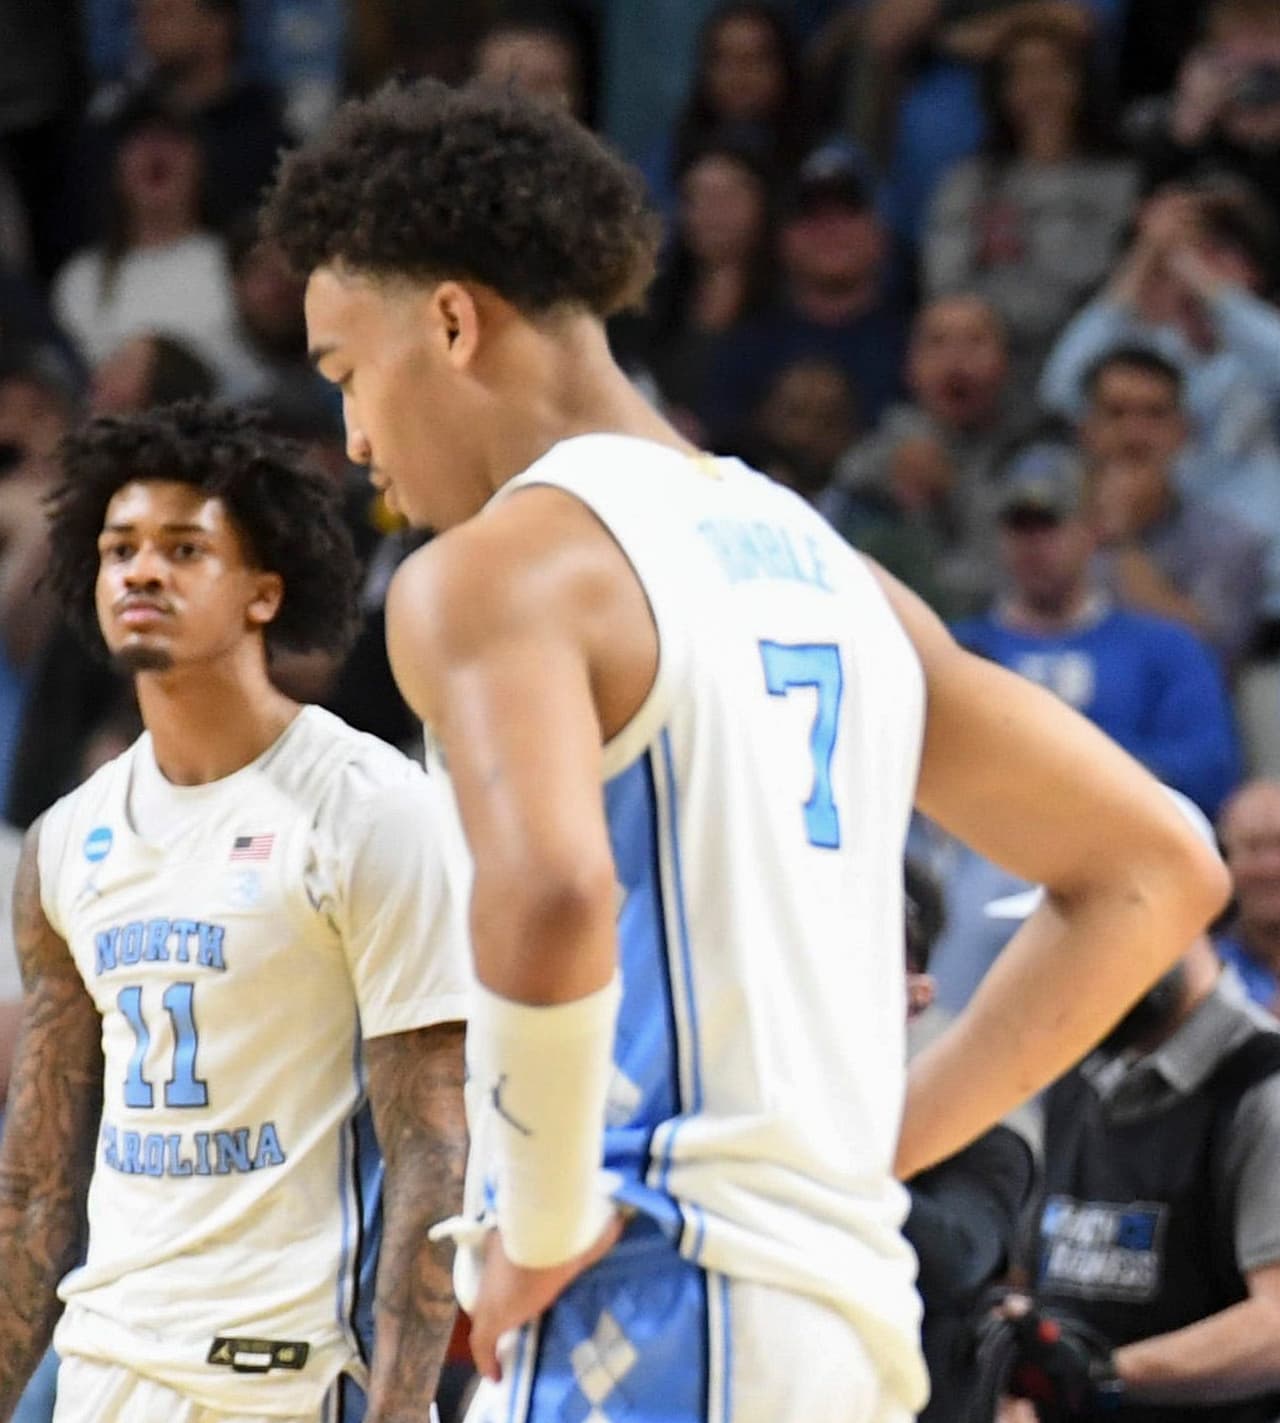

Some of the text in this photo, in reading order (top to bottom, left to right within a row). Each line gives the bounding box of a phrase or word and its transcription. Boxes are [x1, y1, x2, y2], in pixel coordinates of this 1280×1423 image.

[757, 638, 843, 850] 7
[94, 917, 227, 975] NORTH
[117, 981, 209, 1108] 11
